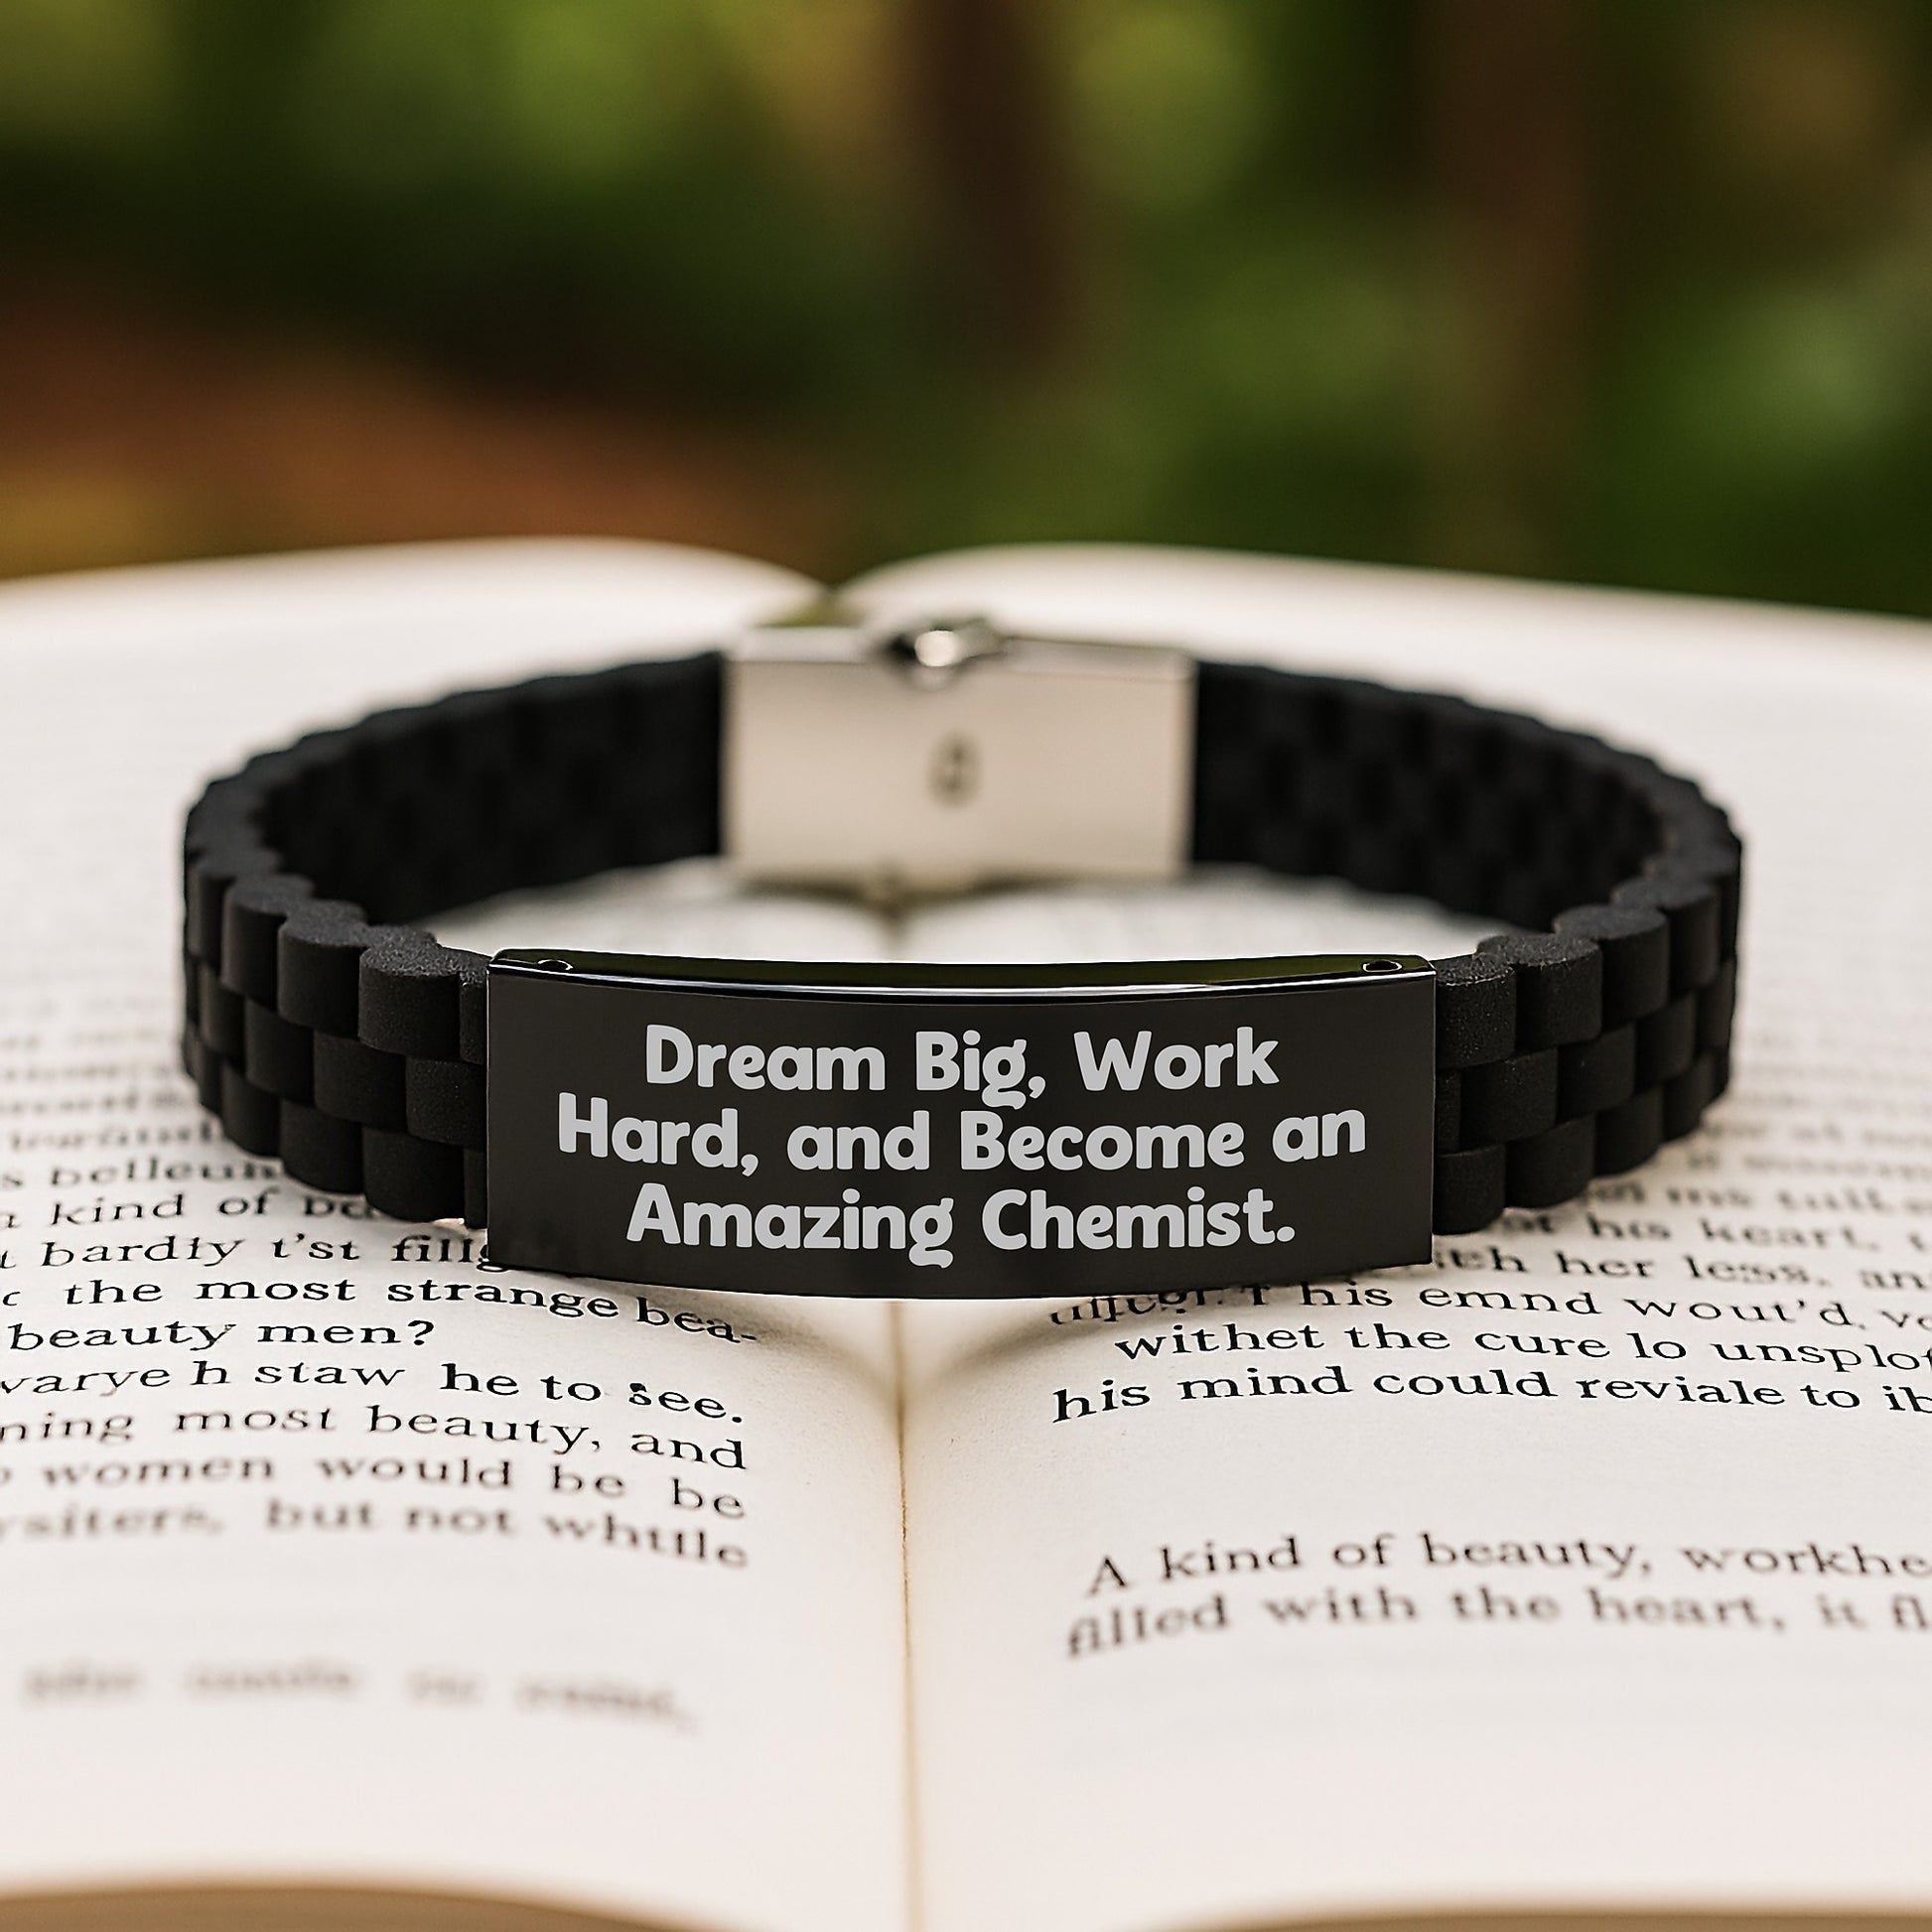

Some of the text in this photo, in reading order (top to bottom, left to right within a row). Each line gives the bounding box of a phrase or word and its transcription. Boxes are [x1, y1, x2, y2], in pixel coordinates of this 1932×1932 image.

[646, 1025, 1279, 1109] Dream Big, Work
[559, 1092, 1365, 1176] Hard, and Become an
[50, 1193, 185, 1227] kind
[217, 1185, 280, 1218] of
[626, 1183, 1295, 1268] Amazing Chemist.
[1554, 1250, 1653, 1278] her
[64, 1280, 163, 1305] the
[194, 1280, 355, 1301] most
[388, 1279, 619, 1318] strange
[1419, 1288, 1602, 1314] emnd
[8, 1320, 434, 1351] beauty men?
[1115, 1323, 1325, 1360] withet
[1343, 1323, 1450, 1349] the
[1475, 1333, 1610, 1357] cure
[255, 1362, 405, 1386] staw
[440, 1363, 519, 1396] he
[540, 1375, 601, 1401] to
[1052, 1379, 1150, 1423] his
[1176, 1366, 1354, 1400] mind
[1373, 1369, 1559, 1397] could
[1576, 1376, 1785, 1405] reviale
[1800, 1385, 1860, 1408] to
[176, 1408, 331, 1432] most
[366, 1405, 600, 1454] beauty,
[631, 1435, 748, 1469] and
[43, 1458, 275, 1486] women
[318, 1457, 511, 1488] would
[552, 1463, 624, 1496] be
[672, 1477, 745, 1518] be
[1090, 1556, 1128, 1595] A
[1160, 1536, 1301, 1582] kind
[1332, 1533, 1393, 1567] of
[1419, 1531, 1651, 1579] beauty,
[1263, 1586, 1419, 1623] with
[1449, 1584, 1560, 1620] the
[1585, 1586, 1786, 1632] heart,
